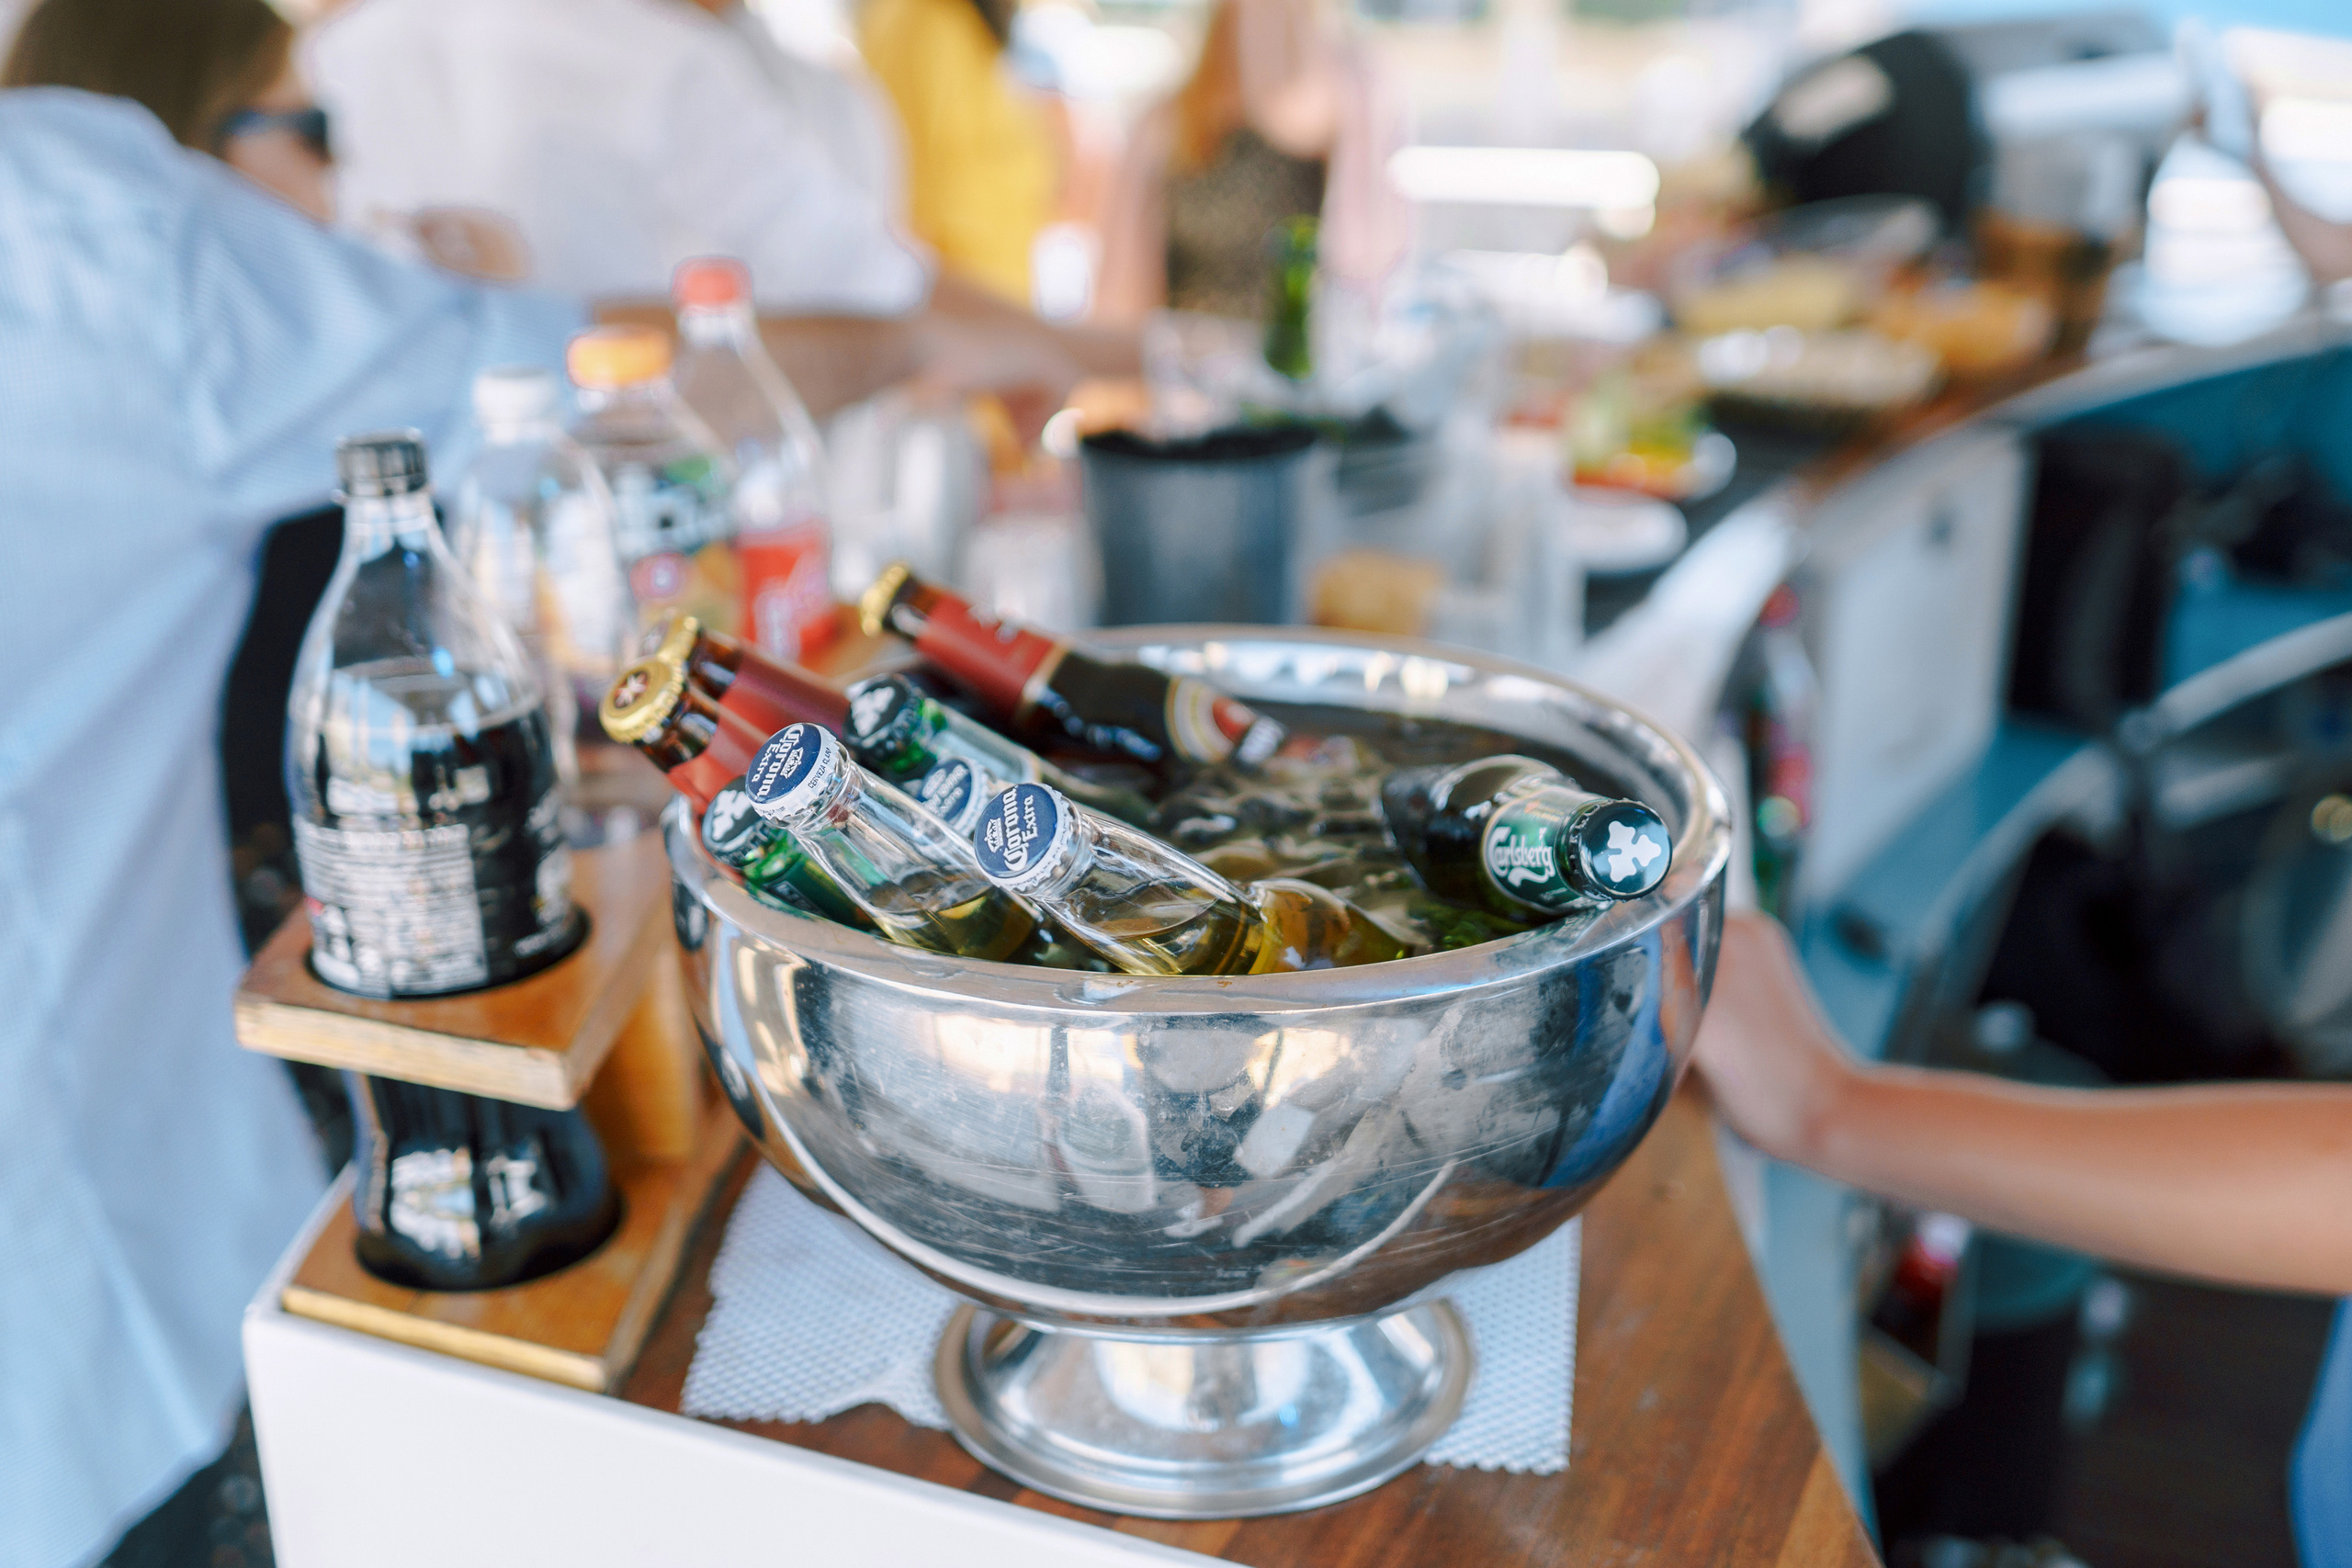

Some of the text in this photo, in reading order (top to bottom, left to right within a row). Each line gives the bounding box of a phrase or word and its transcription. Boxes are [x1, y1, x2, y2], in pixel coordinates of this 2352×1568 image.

[752, 743, 781, 783] Extra
[754, 724, 804, 800] Corona
[808, 764, 827, 789] CERVEZA
[922, 763, 968, 813] orona
[1002, 785, 1029, 872] Corona
[1021, 795, 1038, 842] Extra
[1489, 827, 1555, 887] Carlsberg
